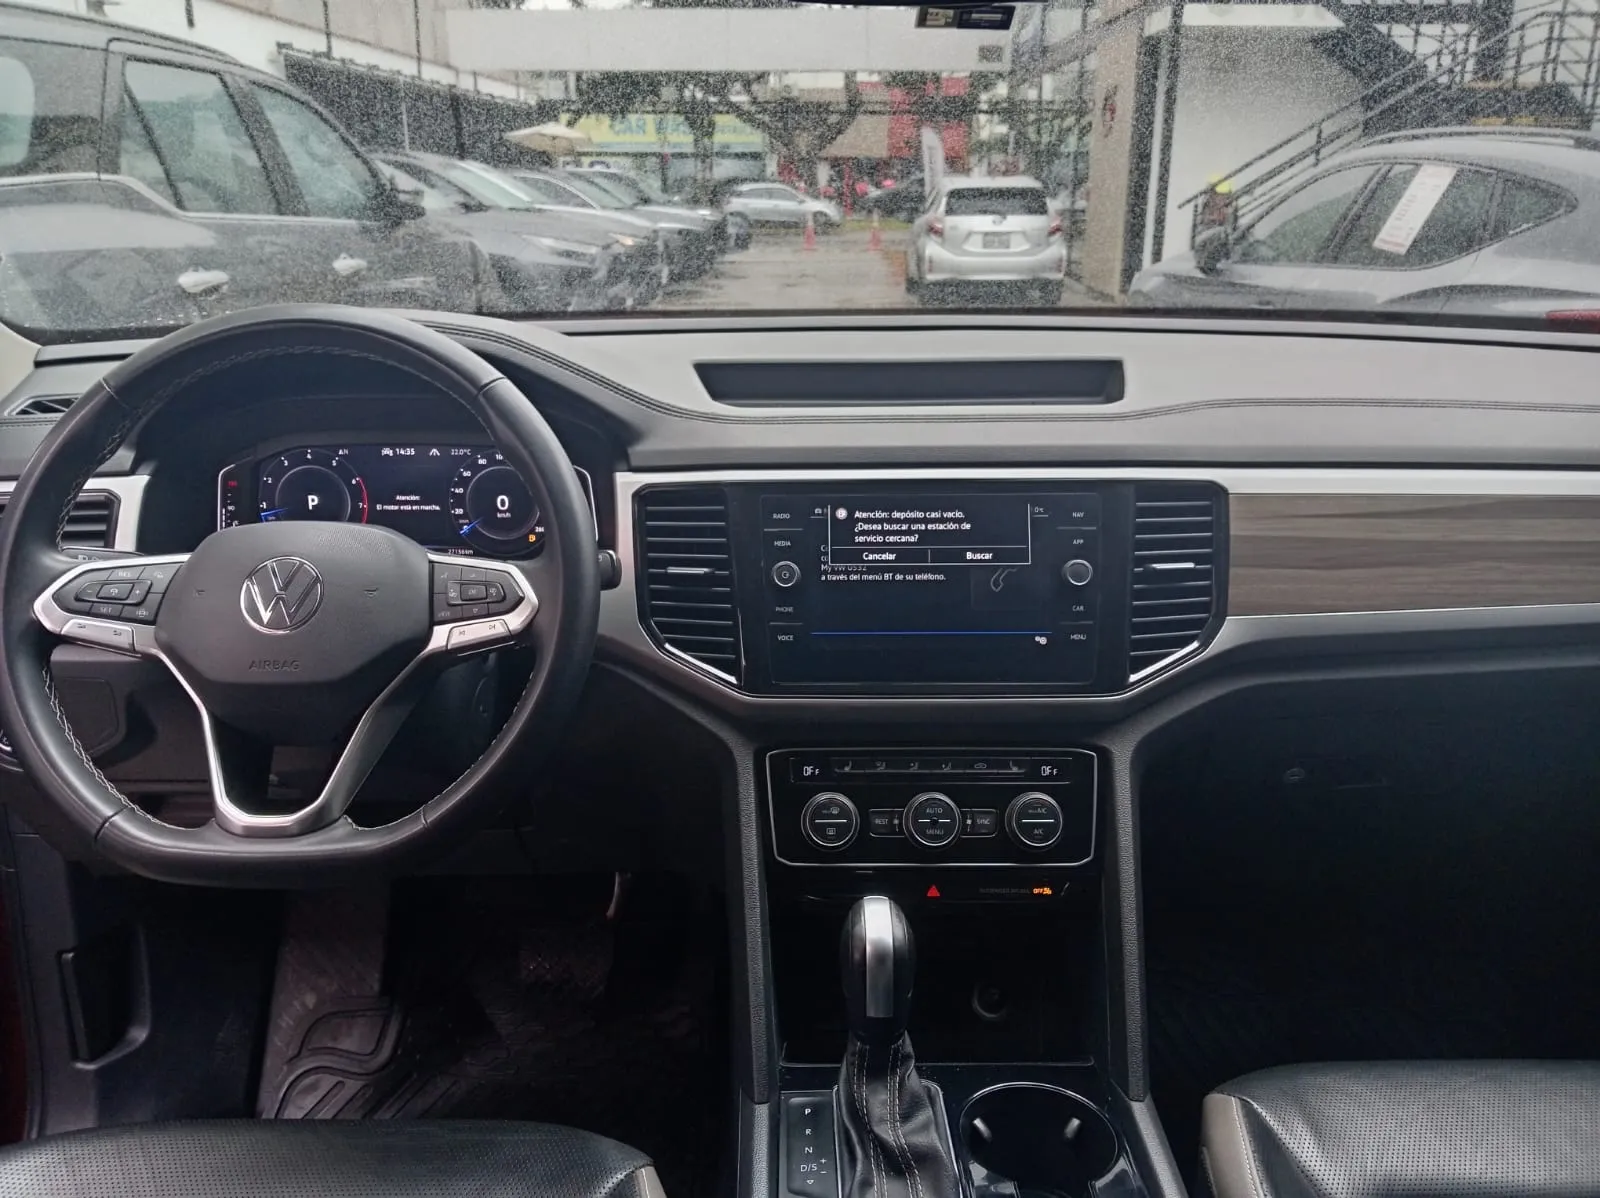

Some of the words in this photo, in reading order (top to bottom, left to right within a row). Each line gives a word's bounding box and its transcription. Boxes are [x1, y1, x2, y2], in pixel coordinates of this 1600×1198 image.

[307, 495, 318, 510] P
[496, 495, 509, 510] 0
[854, 510, 890, 518] Atención:
[892, 510, 924, 520] depósito
[926, 510, 941, 518] casi
[943, 510, 965, 518] vacío.
[854, 522, 882, 532] ¿Desea
[884, 522, 909, 530] buscar
[927, 522, 959, 530] estación
[885, 534, 919, 542] cercana?
[862, 552, 896, 560] Cancelar
[966, 551, 993, 560] Buscar
[915, 572, 946, 580] teléfono.
[249, 660, 299, 671] AIRBAG
[803, 766, 819, 776] OFF
[1041, 766, 1057, 776] OFF
[800, 1164, 817, 1172] D/S
